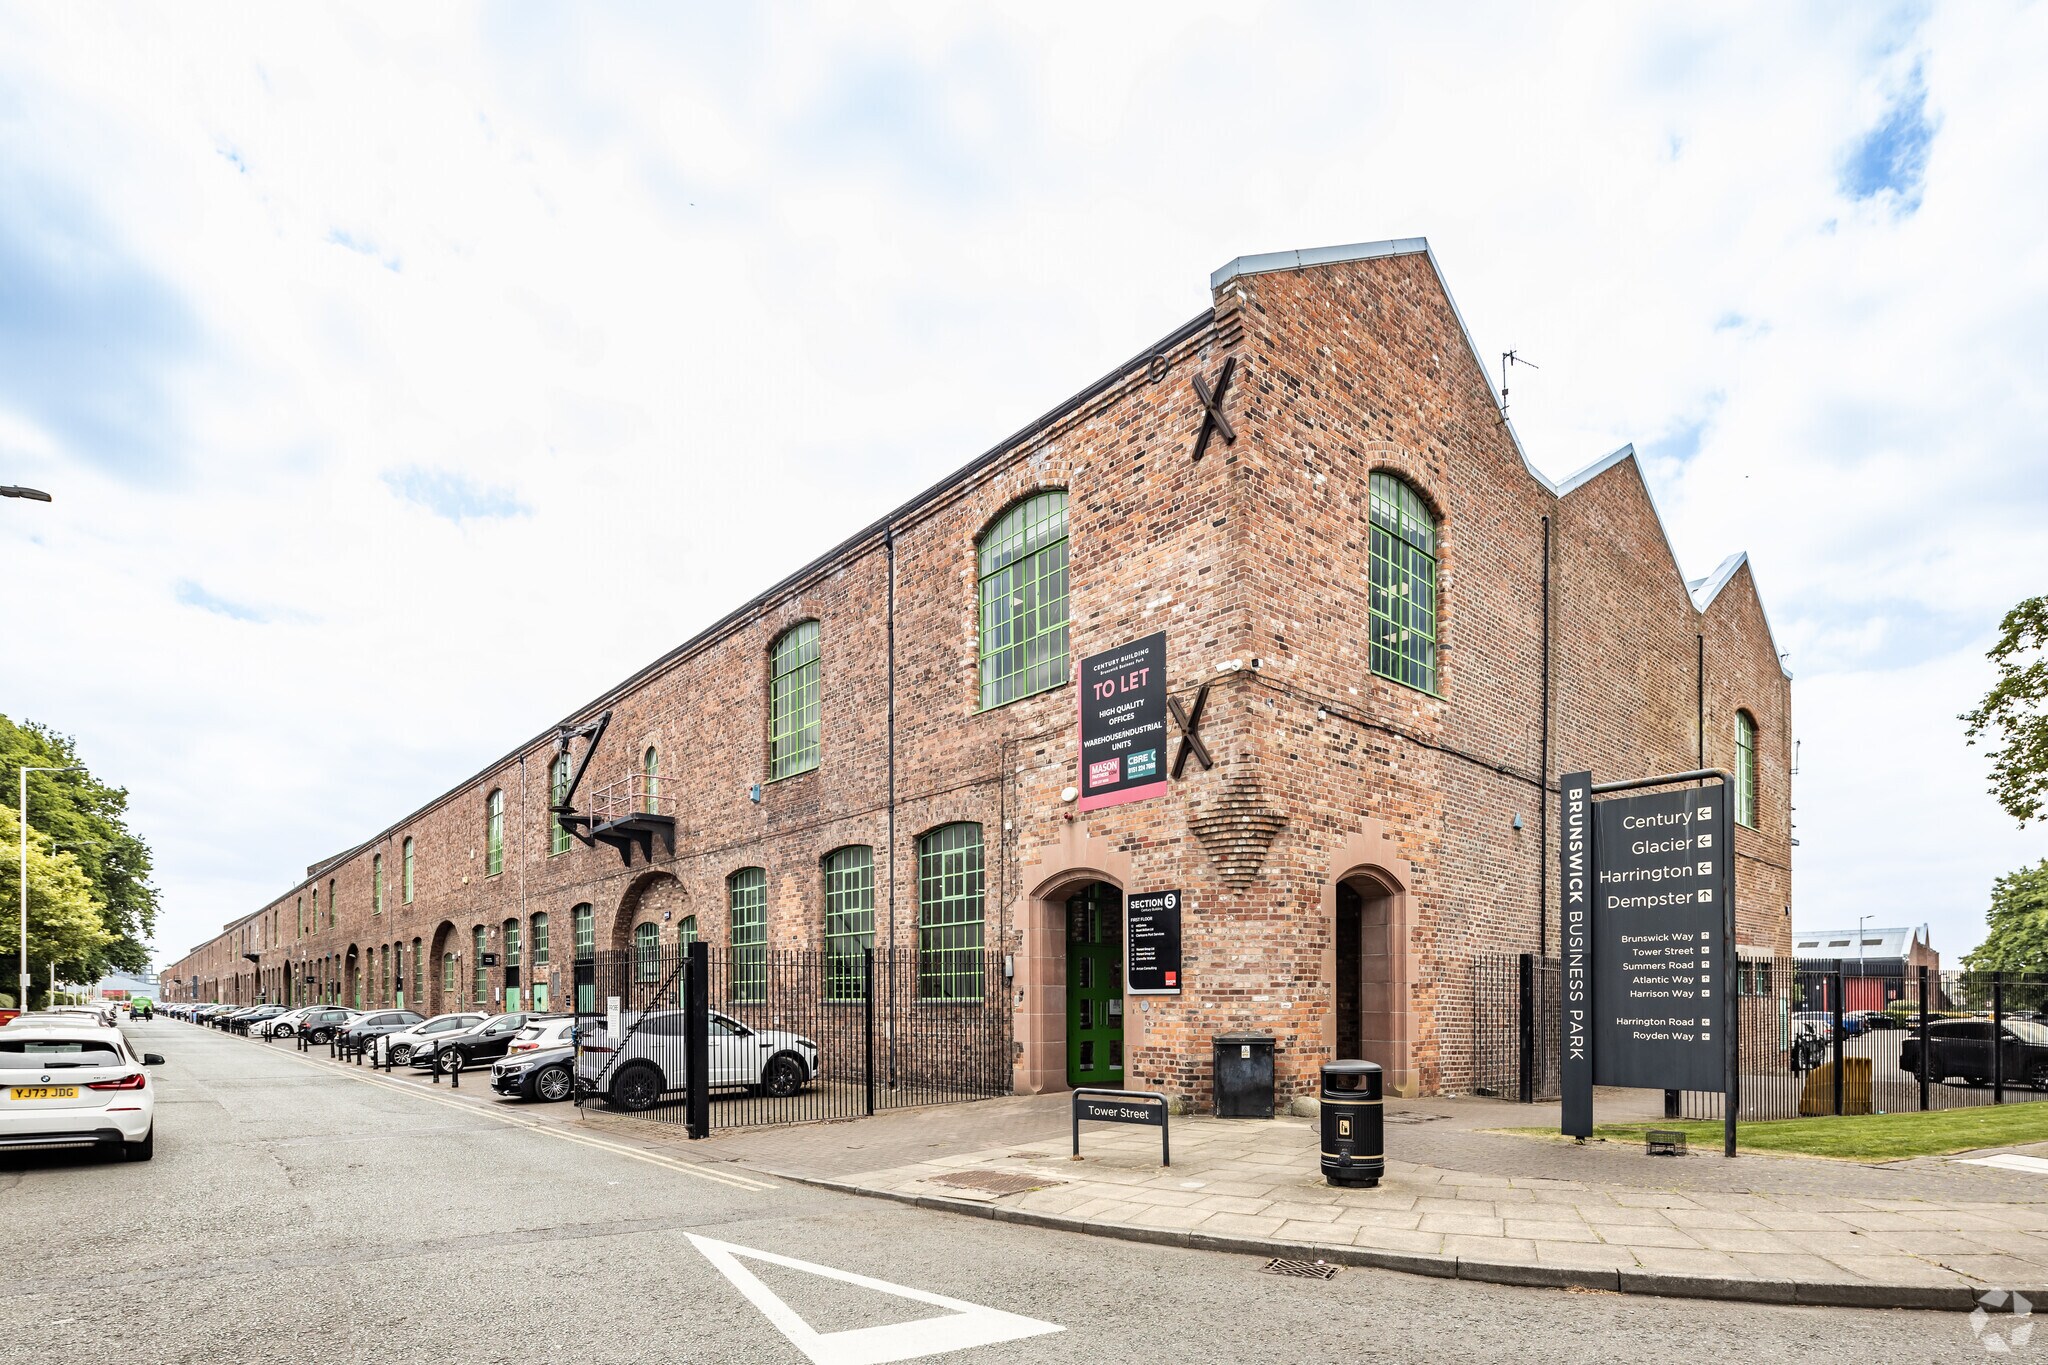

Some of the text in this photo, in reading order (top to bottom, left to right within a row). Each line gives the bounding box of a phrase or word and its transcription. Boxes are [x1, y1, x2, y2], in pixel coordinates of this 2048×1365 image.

[1093, 647, 1150, 672] CENTURY BUILDING
[1100, 666, 1119, 676] Brunswick
[1119, 661, 1135, 670] Business
[1093, 667, 1150, 701] TO LET
[1098, 698, 1145, 719] HIGH QUALITY
[1108, 712, 1135, 726] OFFICES
[1083, 721, 1163, 748] WAREHOUSE/INDUSTRIAL
[1111, 739, 1132, 751] UNITS
[1127, 753, 1149, 765] CBRE
[1091, 760, 1118, 775] MASON
[1623, 811, 1693, 831] Century
[1631, 838, 1693, 855] Glacier
[1600, 863, 1693, 884] Harrington
[1130, 895, 1173, 909] SECTION 5
[1608, 891, 1693, 909] Dempster
[1569, 788, 1584, 1060] BRUNSWICK BUSINESS PARK
[1621, 932, 1694, 944] Brunswick Way
[1632, 946, 1694, 957] Tower Street
[1622, 960, 1694, 971] Summers Road
[1632, 975, 1695, 985] Atlantic Way
[1630, 989, 1695, 999] Harrison Way
[1616, 1017, 1695, 1027] Harrington Road
[1633, 1031, 1695, 1042] Royden Way
[15, 1087, 74, 1098] YJ73 JDG
[1088, 1105, 1149, 1120] Tower Street
